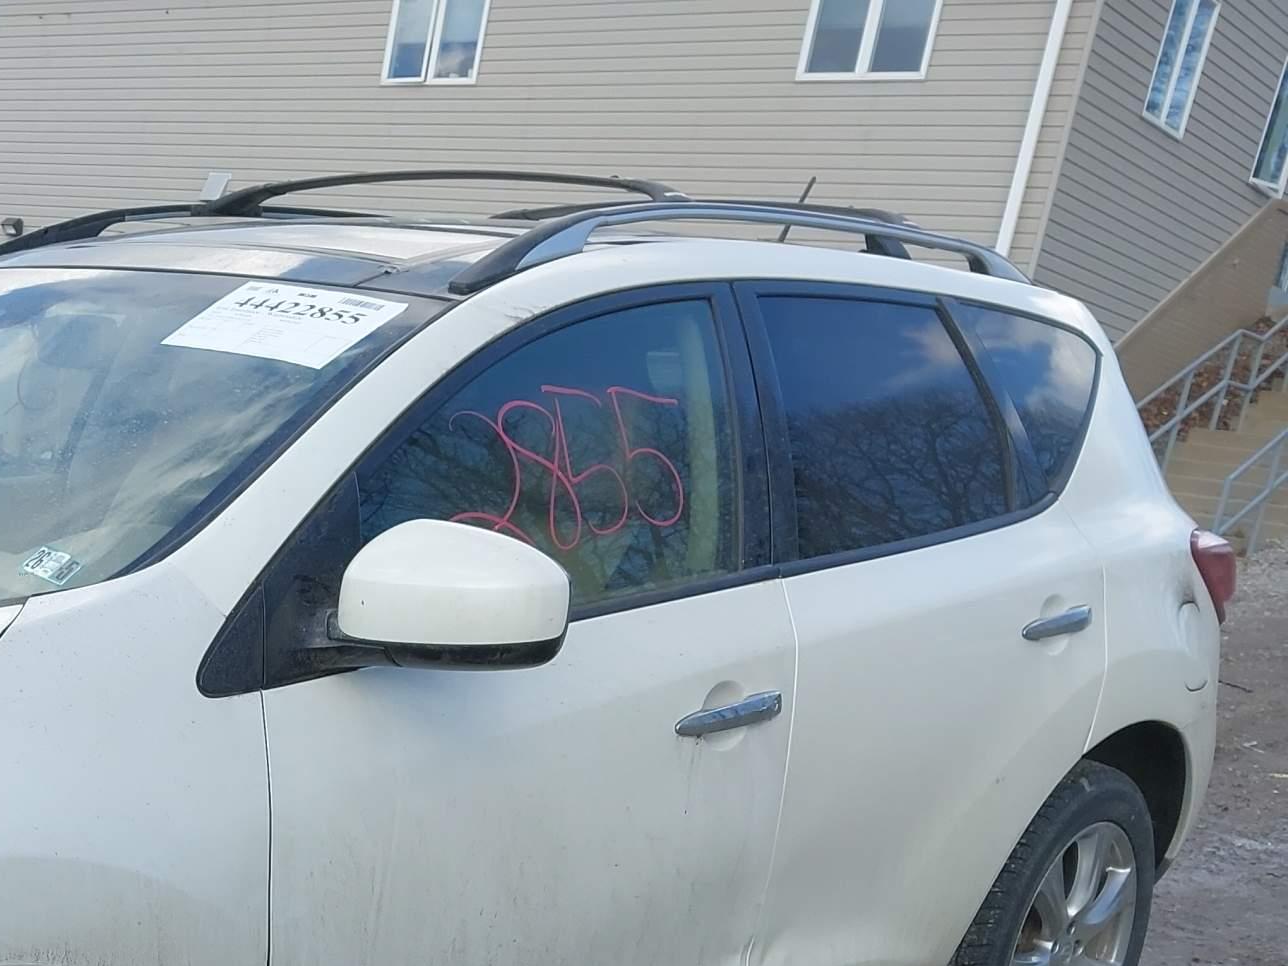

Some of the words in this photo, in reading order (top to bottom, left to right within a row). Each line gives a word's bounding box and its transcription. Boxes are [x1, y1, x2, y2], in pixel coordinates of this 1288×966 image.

[235, 297, 368, 324] 44422855
[450, 386, 683, 549] 2855
[26, 550, 51, 569] 26
